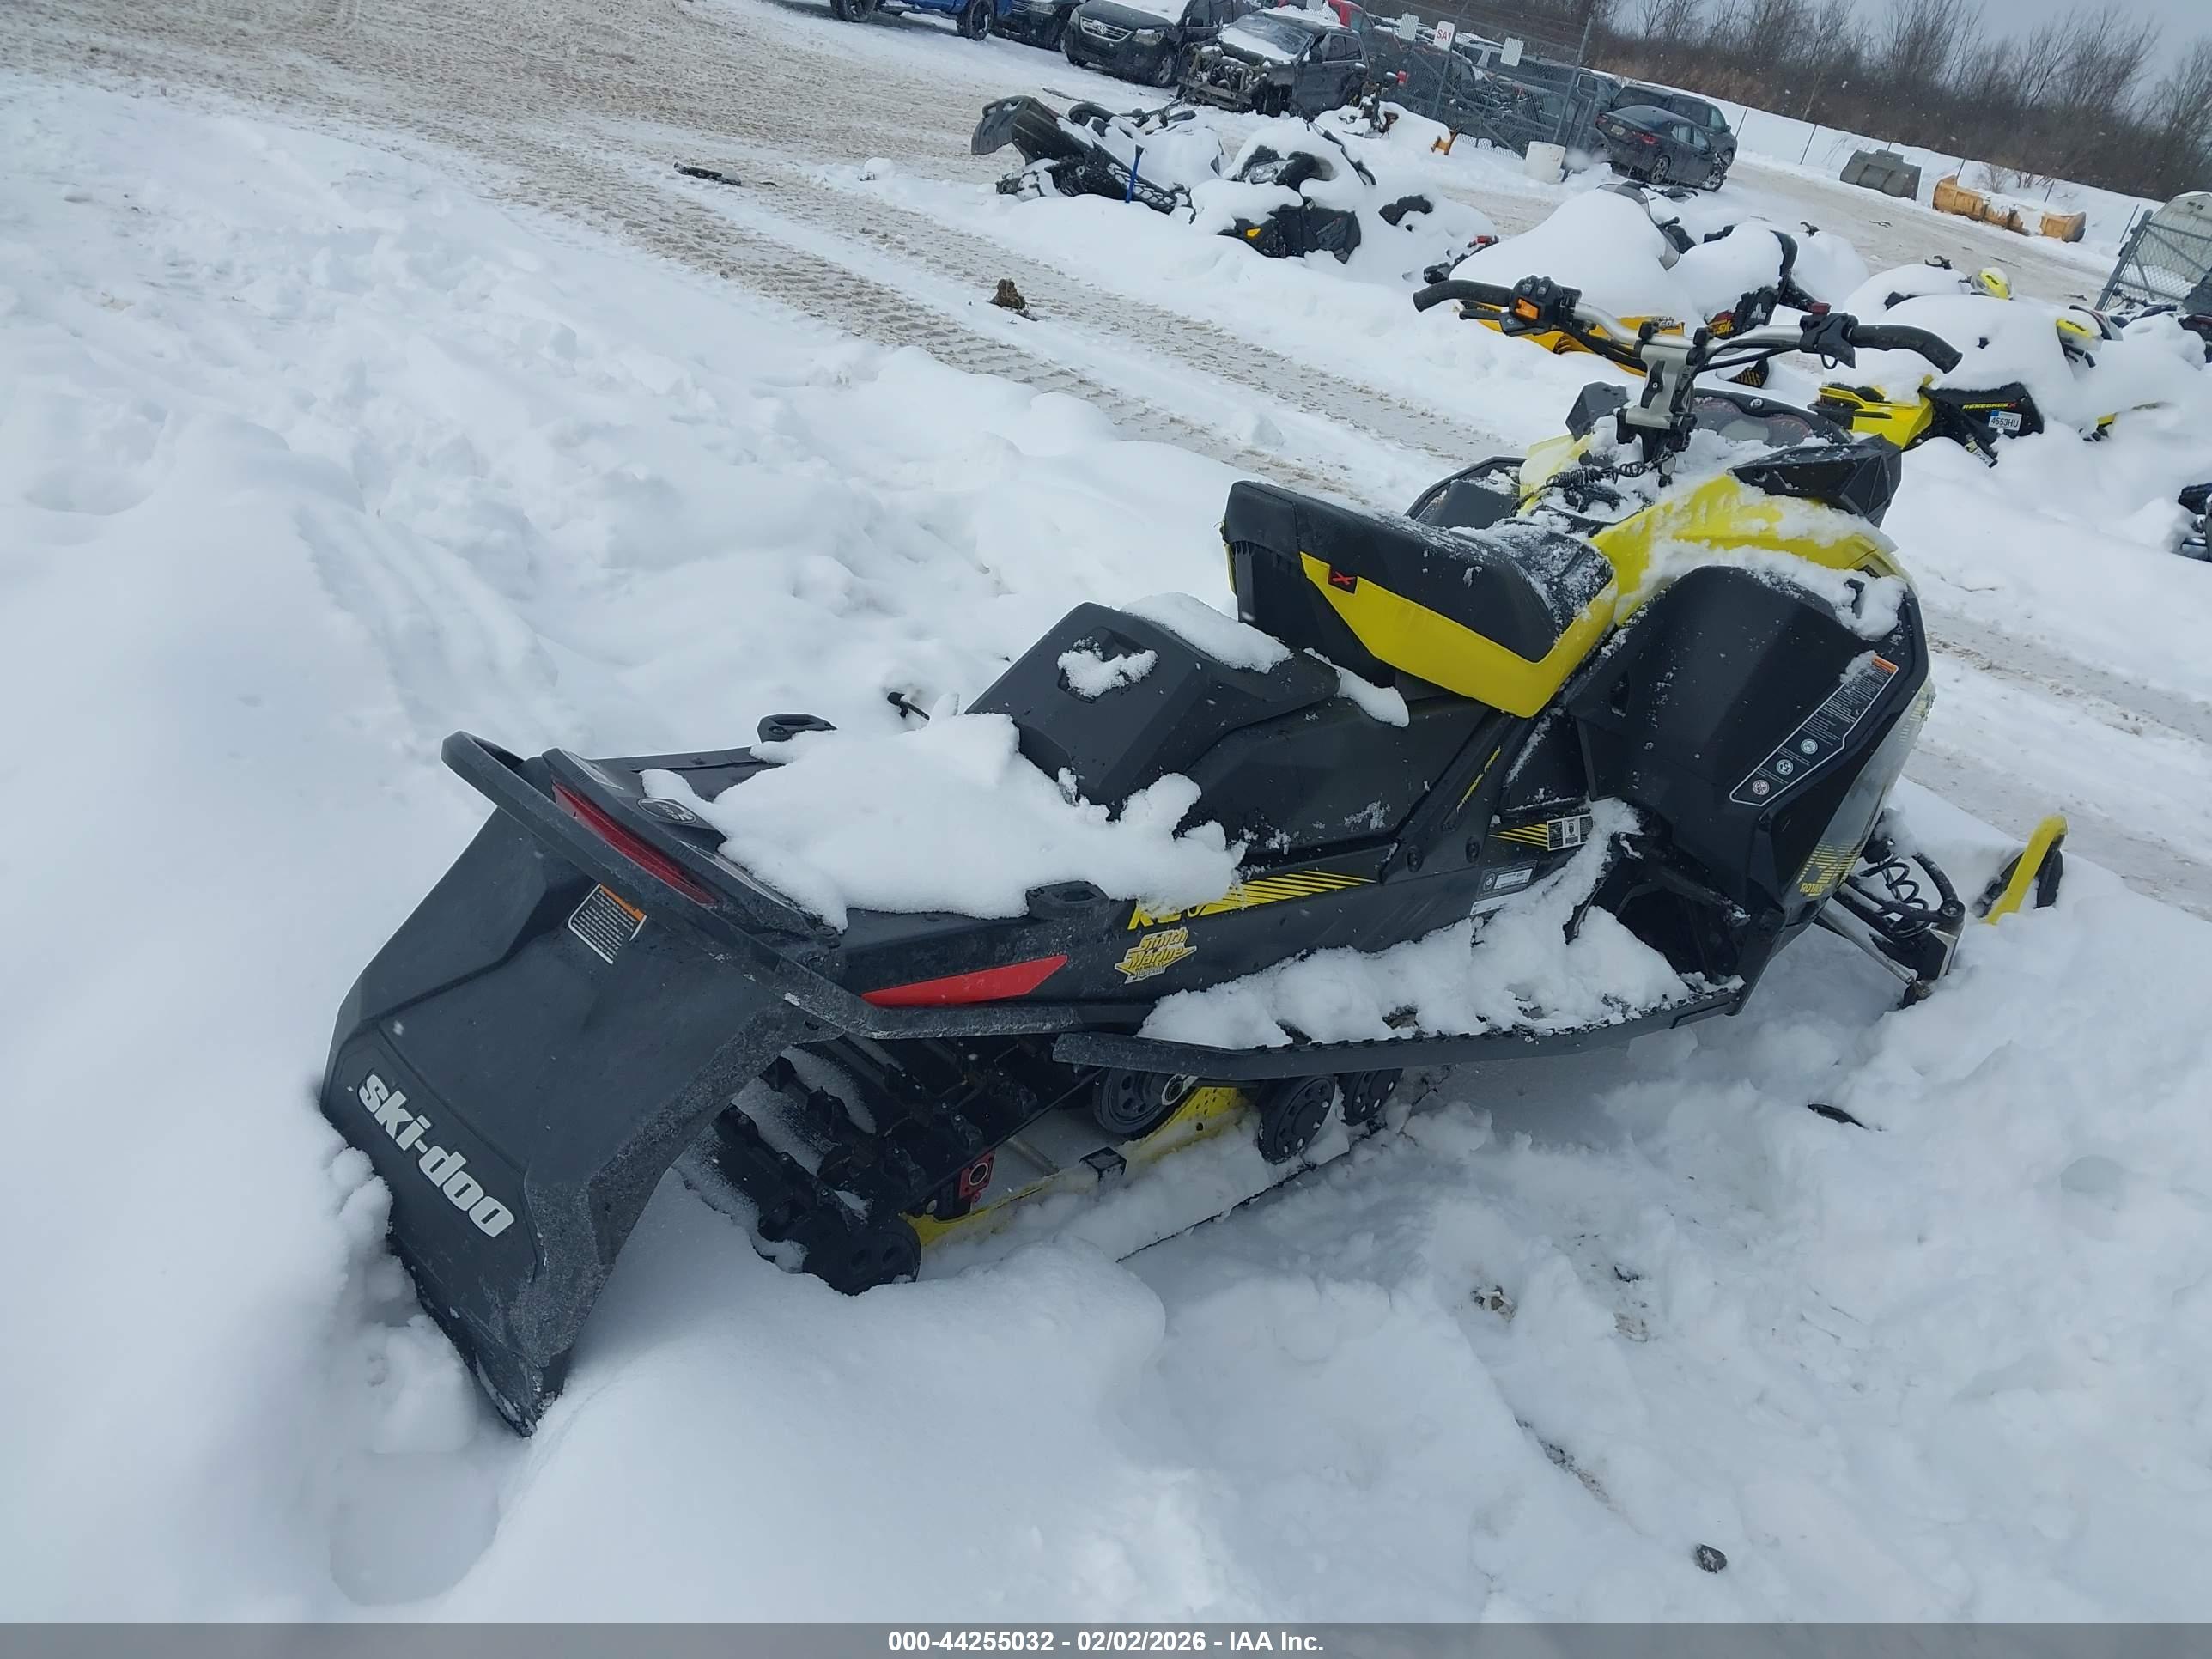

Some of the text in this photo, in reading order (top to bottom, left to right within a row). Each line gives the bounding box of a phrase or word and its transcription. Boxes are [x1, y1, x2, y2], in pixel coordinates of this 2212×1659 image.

[1437, 28, 1452, 41] SA1
[1140, 928, 1188, 950] Smith
[1127, 946, 1184, 969] Marine
[358, 1073, 515, 1237] ski-doo
